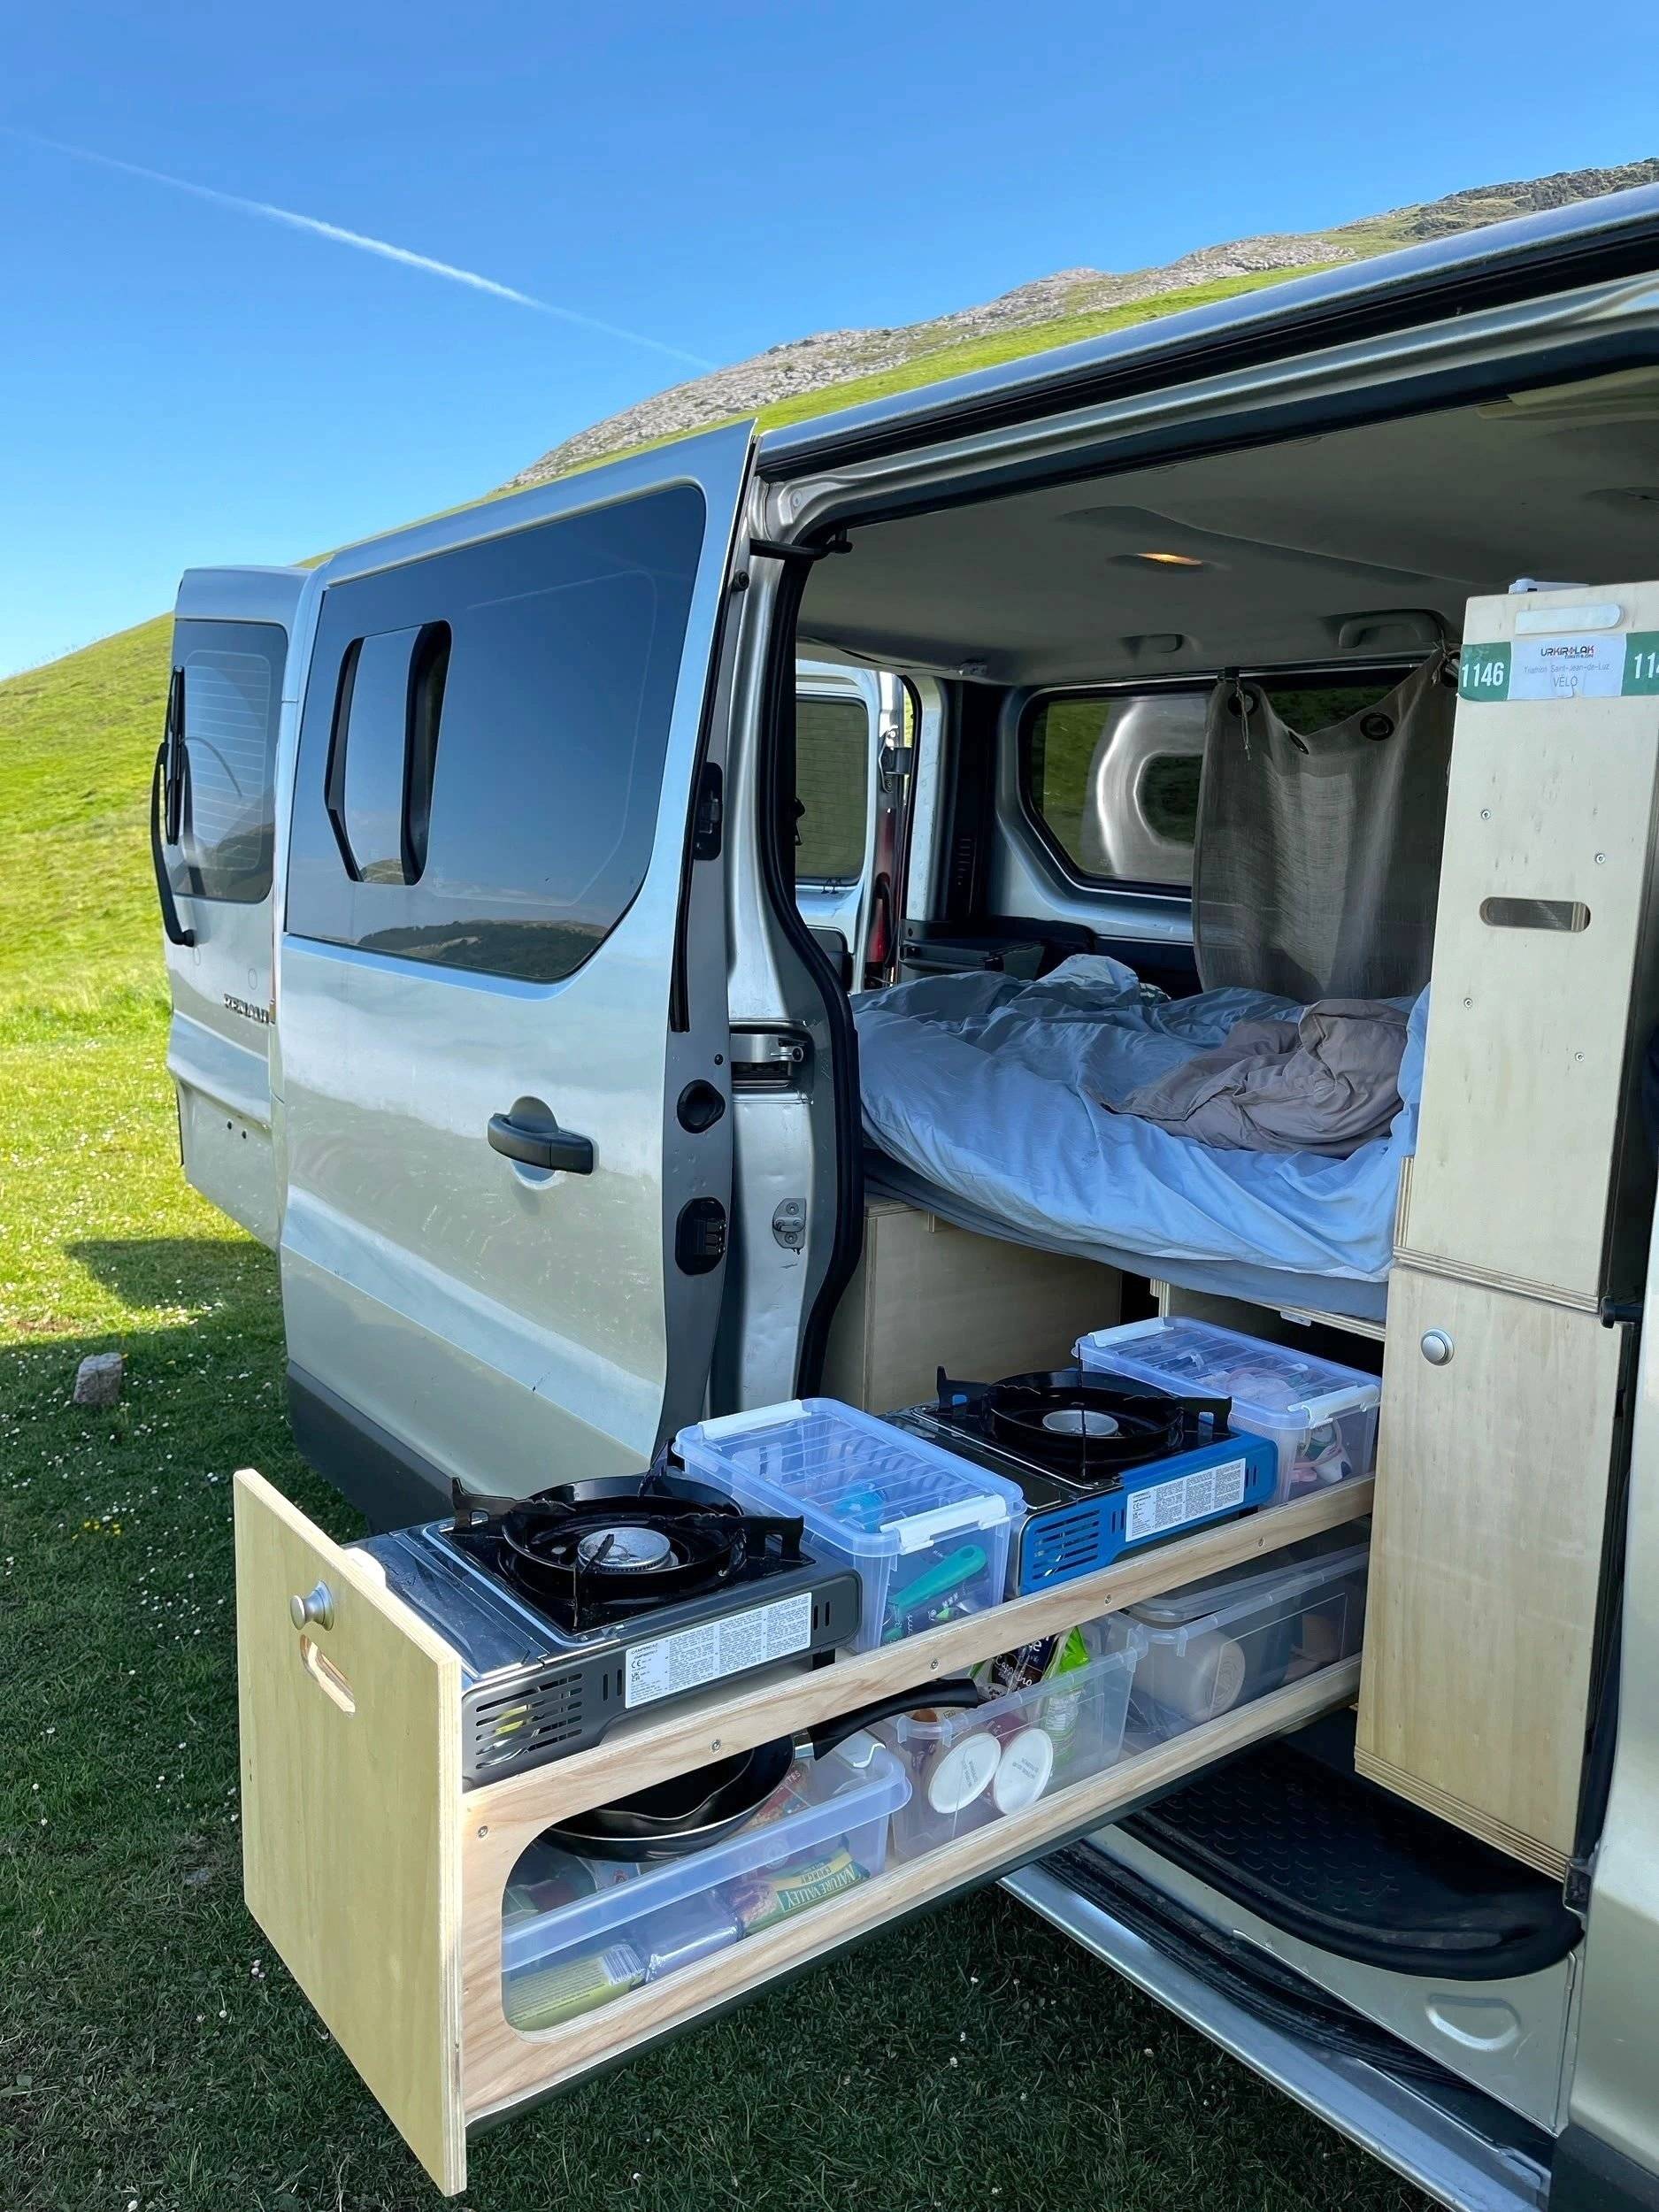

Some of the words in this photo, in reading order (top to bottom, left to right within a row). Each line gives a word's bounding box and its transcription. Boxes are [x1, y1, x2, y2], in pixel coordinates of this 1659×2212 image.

[1462, 662, 1504, 687] 1146
[1634, 651, 1659, 679] 11
[820, 1863, 856, 1893] NATURE
[785, 1886, 821, 1909] VALLEY
